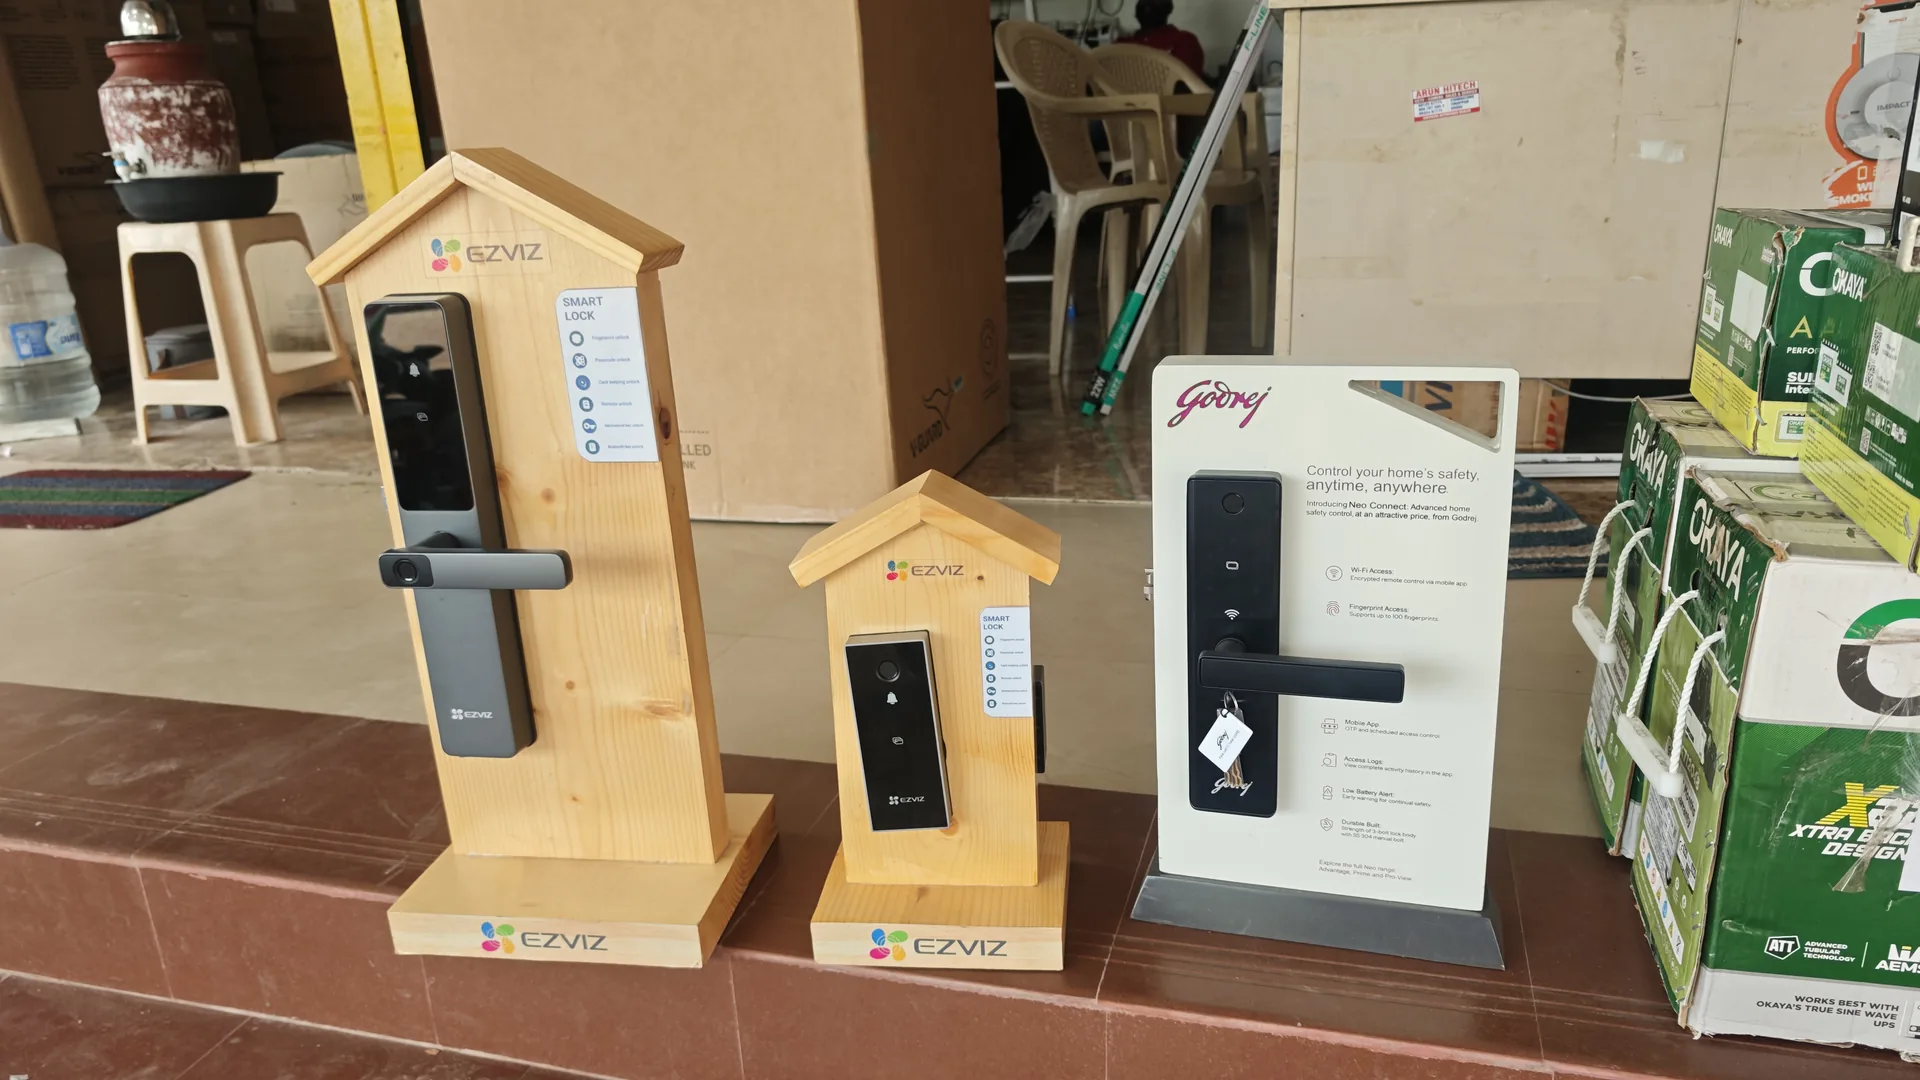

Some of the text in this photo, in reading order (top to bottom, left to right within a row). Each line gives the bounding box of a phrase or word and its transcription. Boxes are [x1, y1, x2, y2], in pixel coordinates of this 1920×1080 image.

[1416, 88, 1439, 98] ARUN
[1444, 81, 1476, 92] HITECH
[1877, 100, 1911, 112] IMPACT
[1714, 224, 1732, 248] OKAYA
[466, 244, 543, 262] EZVIZ
[1832, 268, 1866, 302] OKAYA
[563, 296, 603, 307] SMART
[565, 310, 595, 321] LOCK
[1167, 380, 1272, 428] Godrej
[1306, 465, 1480, 482] Control your home's safety,
[1306, 480, 1448, 495] anytime, anywhere.
[1306, 501, 1347, 509] Introducing
[1370, 502, 1408, 510] Connect:
[912, 564, 964, 576] EZVIZ
[1788, 824, 1854, 840] XTRA
[521, 932, 608, 951] EZVIZ
[914, 938, 1007, 956] EZVIZ
[1769, 939, 1795, 953] ATT
[1804, 941, 1848, 950] ADVANCED
[1803, 953, 1856, 962] TECHNOLOGY
[1804, 947, 1840, 955] TUBULAR
[1875, 960, 1920, 974] AEM
[1756, 1001, 1897, 1020] OKAYA'S TRUE SINE WAVE
[1795, 996, 1899, 1012] WORKS BEST WITH
